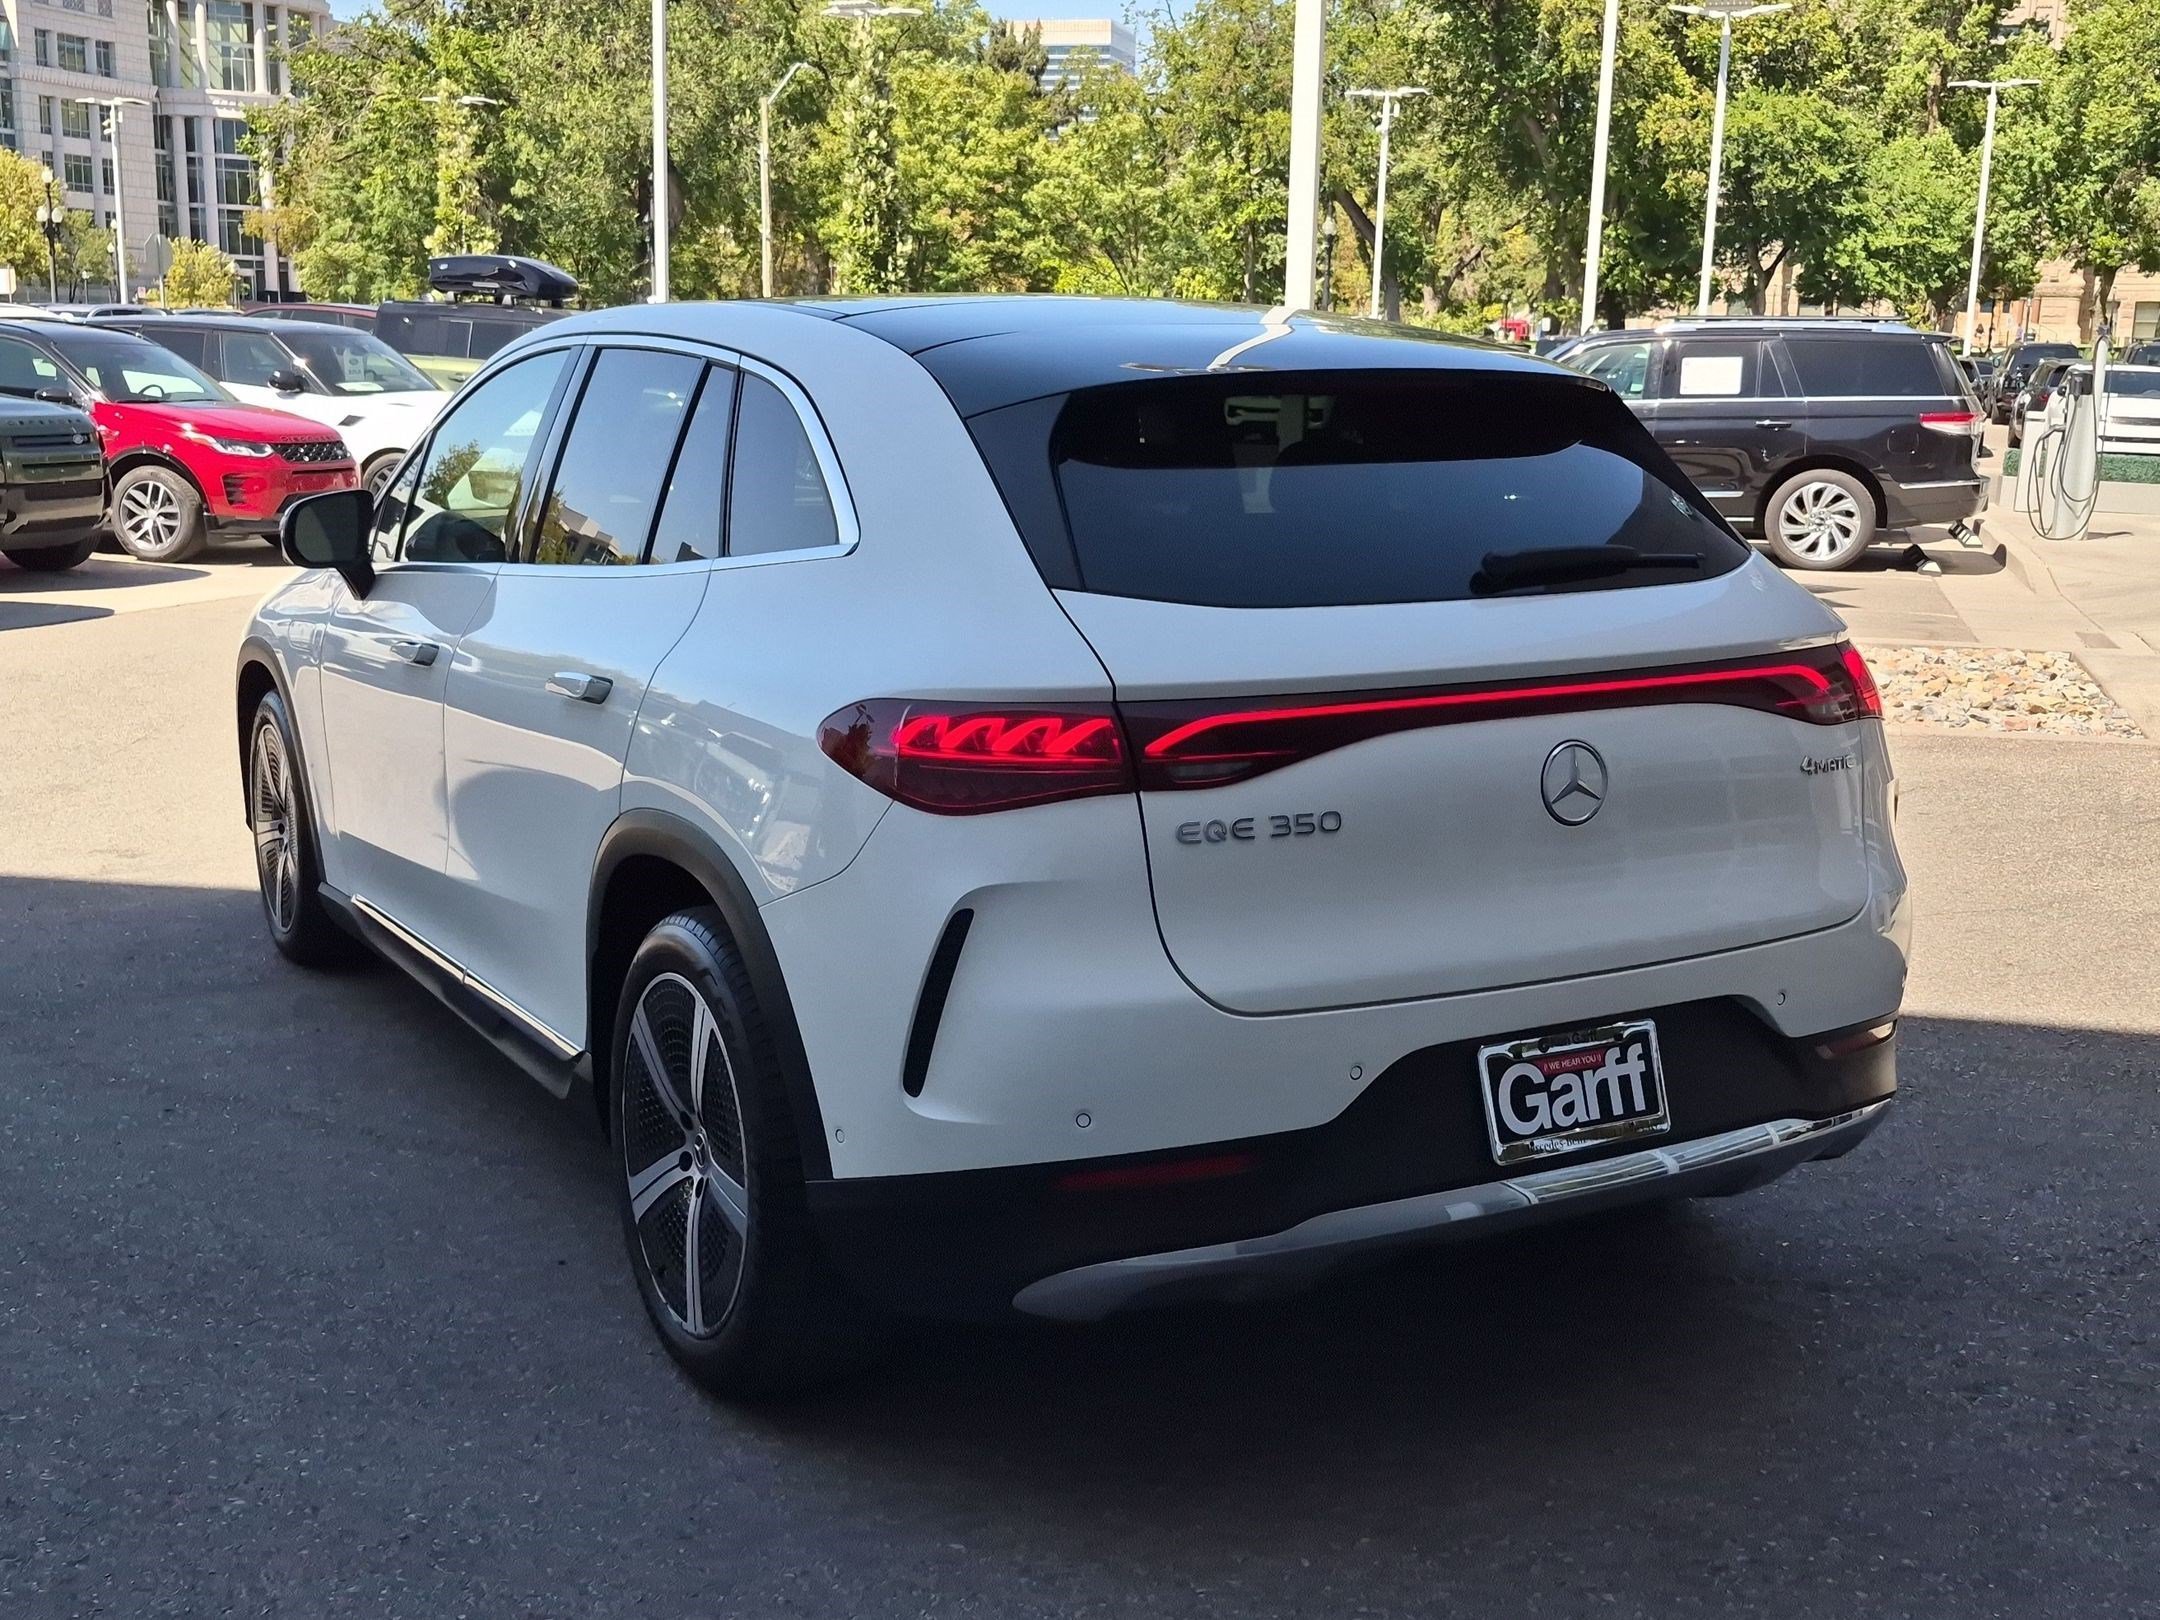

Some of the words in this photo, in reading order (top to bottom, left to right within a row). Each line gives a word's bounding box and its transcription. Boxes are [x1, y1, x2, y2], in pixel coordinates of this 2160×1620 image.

[1175, 817, 1256, 844] EQE
[1268, 810, 1342, 838] 350
[1548, 1060, 1561, 1071] WE
[1561, 1057, 1581, 1068] HEAR
[1581, 1053, 1597, 1065] YOU
[1498, 1043, 1646, 1136] Garff
